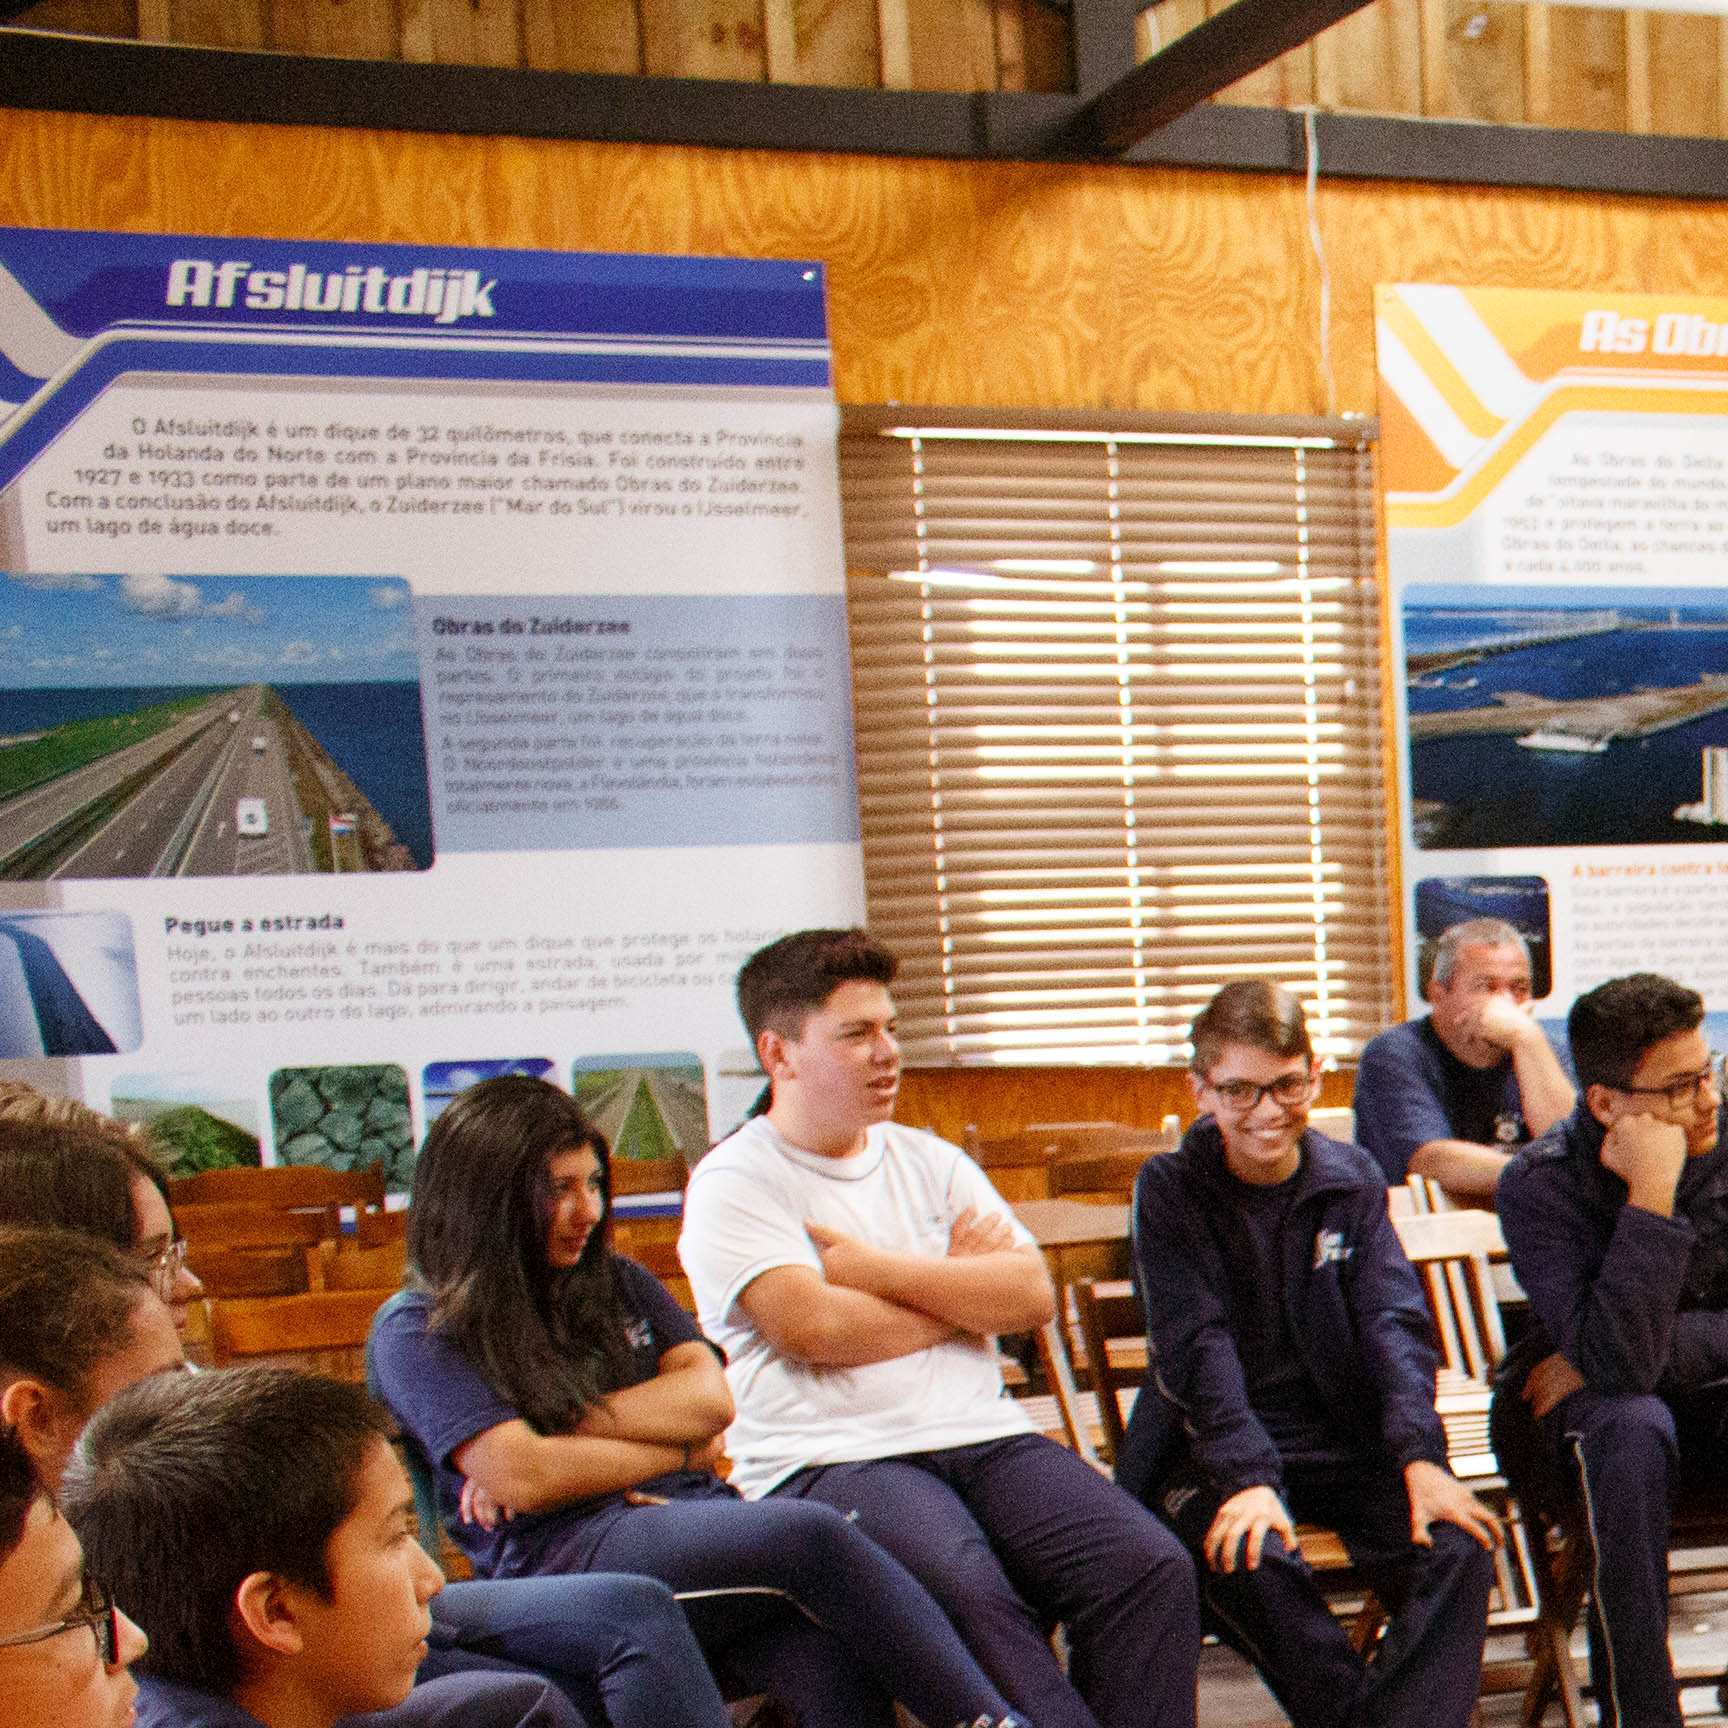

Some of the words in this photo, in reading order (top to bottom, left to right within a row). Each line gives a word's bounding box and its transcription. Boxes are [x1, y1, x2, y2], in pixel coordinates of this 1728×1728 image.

[166, 257, 497, 323] Afsluitdijk
[1579, 310, 1650, 353] As
[132, 418, 145, 436] O
[154, 419, 258, 442] Afsluitdijk
[286, 427, 316, 439] um
[324, 422, 378, 444] dique
[386, 423, 410, 441] de
[417, 424, 439, 441] 32
[578, 432, 612, 449] que
[619, 427, 693, 446] conecta
[700, 434, 710, 446] a
[104, 444, 128, 461] da
[139, 444, 224, 463] Holanda
[233, 446, 258, 463] do
[268, 446, 324, 464] Norte
[334, 452, 376, 465] com
[387, 453, 397, 465] a
[506, 449, 529, 467] da
[609, 451, 638, 468] Foi
[74, 469, 121, 486] 1927
[128, 474, 140, 486] e
[149, 470, 194, 487] 1933
[202, 475, 257, 488] como
[264, 471, 318, 492] parte
[325, 471, 348, 489] de
[357, 477, 388, 489] um
[396, 472, 450, 494] plano
[458, 473, 514, 490] maior
[522, 474, 608, 491] chamado
[616, 475, 671, 492] Obras
[678, 475, 700, 492] do
[46, 491, 92, 509] Com
[99, 497, 109, 509] a
[116, 492, 220, 511] conclusão
[226, 493, 250, 511] do
[370, 500, 380, 513] o
[387, 495, 482, 514] Zuiderzee
[550, 497, 572, 515] do
[46, 522, 80, 534] um
[87, 517, 131, 539] lago
[138, 518, 162, 535] de
[169, 518, 219, 539] água
[225, 518, 278, 536] doce.
[433, 617, 493, 635] Obras
[499, 617, 524, 635] do
[530, 617, 631, 635] Zuiderzee
[165, 916, 235, 937] Pegue
[242, 919, 253, 932] a
[260, 913, 345, 931] estrada
[365, 938, 408, 956] mais
[418, 937, 438, 954] do
[446, 941, 481, 956] que
[488, 940, 516, 952] um
[525, 933, 573, 953] dique
[582, 937, 613, 952] que
[169, 966, 230, 984] contra
[474, 961, 514, 973] uma
[172, 990, 248, 1007] pessoas
[255, 983, 306, 1001] todos
[312, 987, 332, 999] os
[418, 983, 458, 998] para
[174, 1013, 204, 1026] um
[210, 1007, 250, 1024] lado
[256, 1010, 278, 1022] ao
[284, 1003, 334, 1021] outro
[340, 1002, 362, 1019] do
